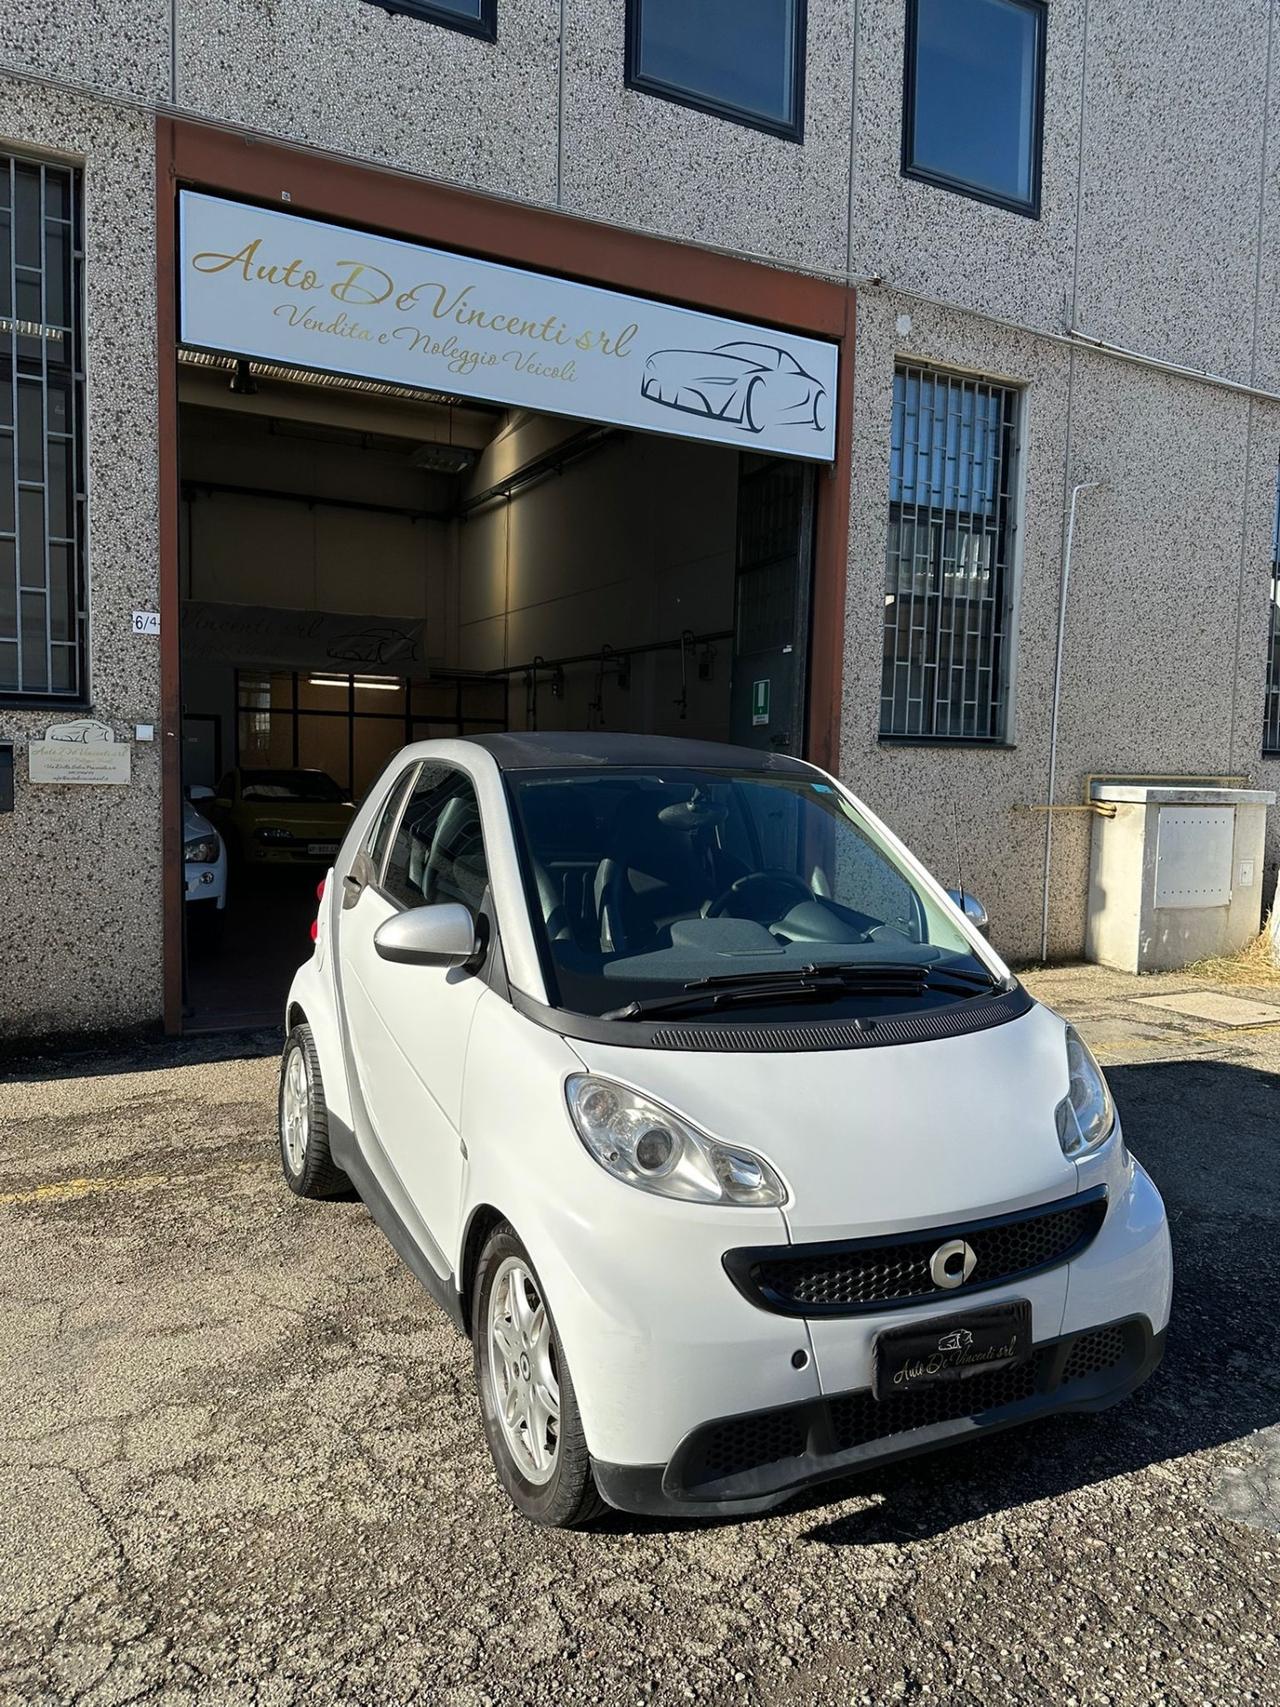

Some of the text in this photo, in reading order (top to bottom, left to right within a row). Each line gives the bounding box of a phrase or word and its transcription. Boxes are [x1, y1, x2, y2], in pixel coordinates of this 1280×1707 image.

[190, 237, 324, 290] Auto
[575, 323, 639, 359] srl
[273, 303, 579, 383] Vendita e Noleggio Veicoli
[893, 1359, 924, 1384] Auto
